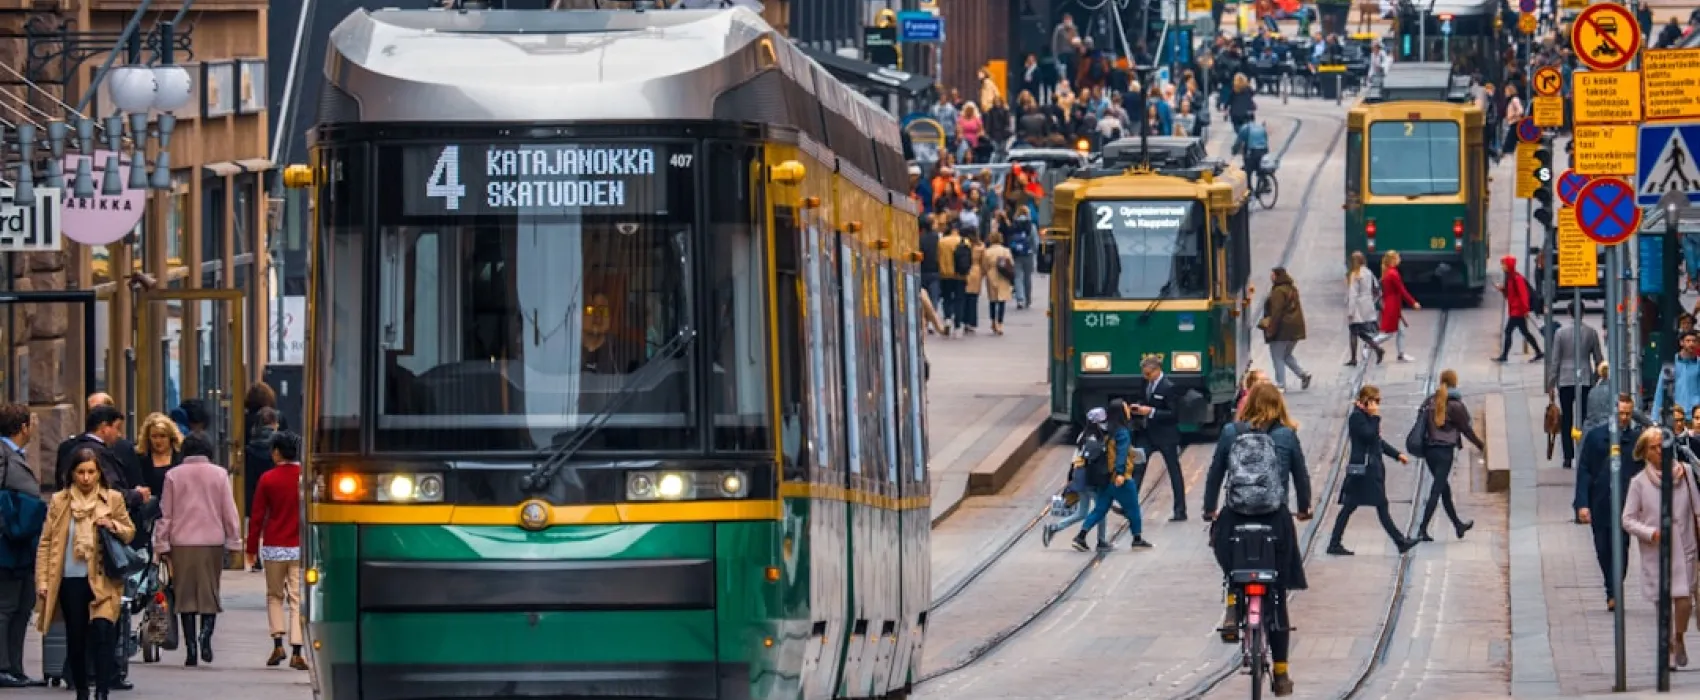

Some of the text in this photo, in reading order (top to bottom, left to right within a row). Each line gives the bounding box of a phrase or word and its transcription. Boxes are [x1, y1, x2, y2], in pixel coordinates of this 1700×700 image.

[669, 153, 693, 168] 407
[426, 146, 654, 210] 4 KATAJANOKKA
[1540, 168, 1550, 181] S
[487, 181, 624, 206] SKATUDDEN
[1096, 205, 1113, 230] 2
